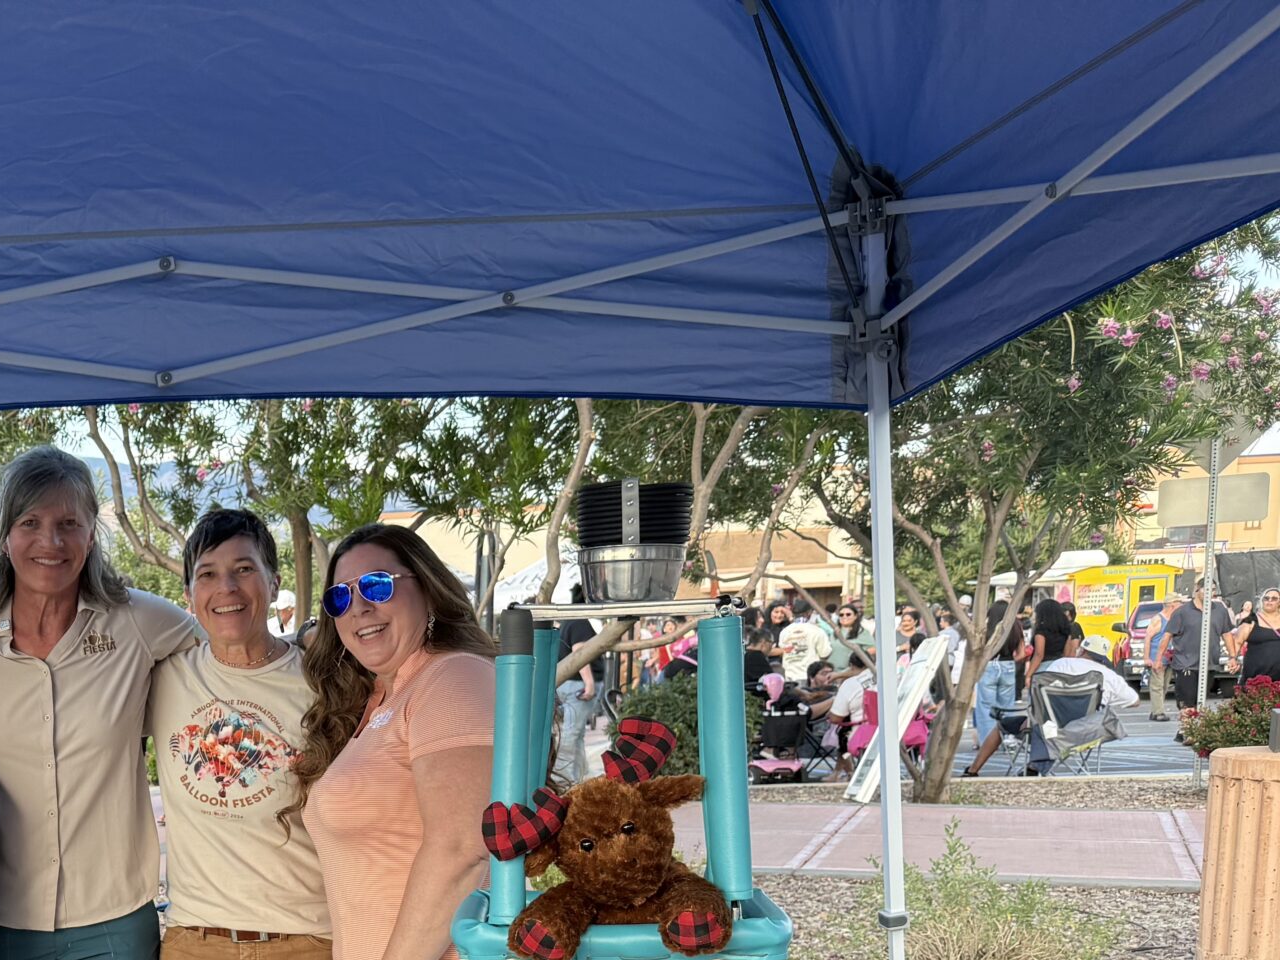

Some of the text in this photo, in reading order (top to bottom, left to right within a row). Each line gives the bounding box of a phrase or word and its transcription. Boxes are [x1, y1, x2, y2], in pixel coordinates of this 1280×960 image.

[83, 641, 117, 655] FIESTA
[236, 699, 285, 733] INTERNATIONAL
[180, 774, 276, 808] BALLOON FIESTA
